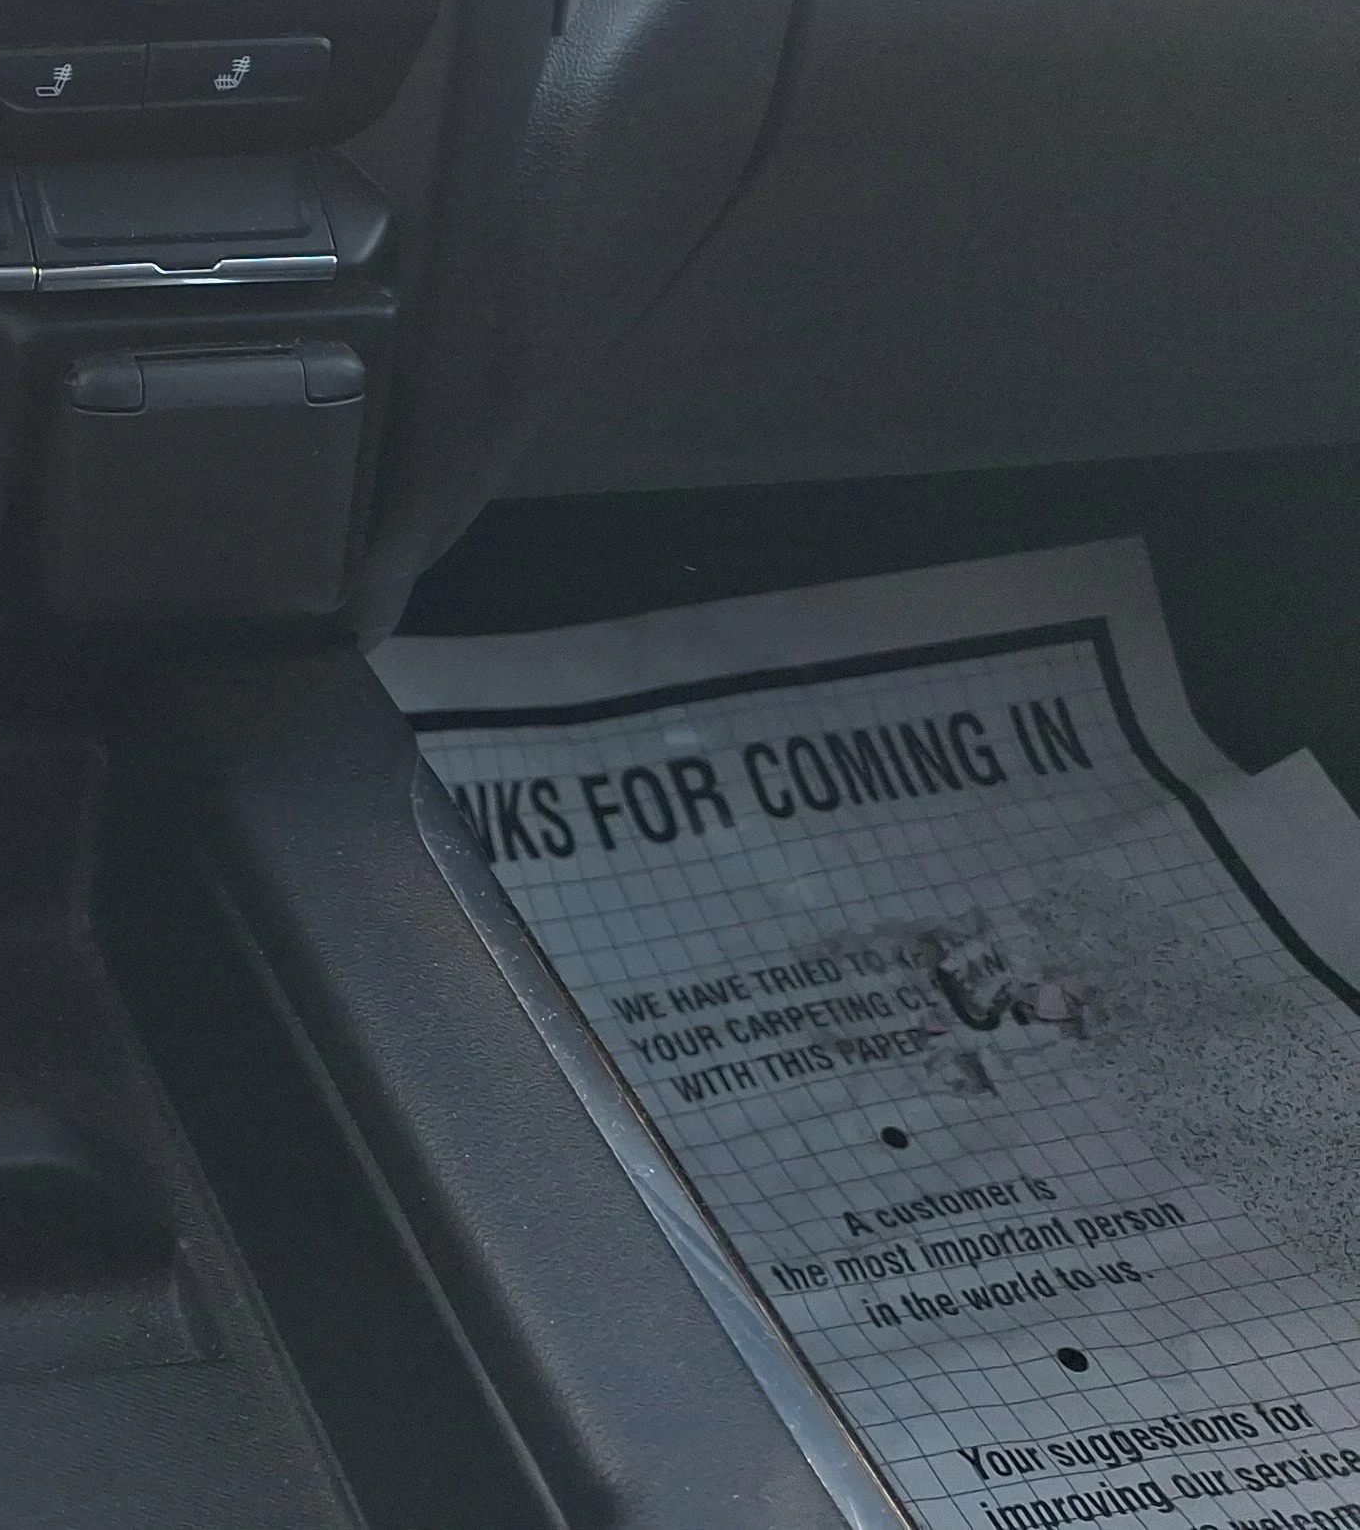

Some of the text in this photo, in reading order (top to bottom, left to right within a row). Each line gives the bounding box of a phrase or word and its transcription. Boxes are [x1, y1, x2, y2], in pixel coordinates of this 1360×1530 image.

[581, 756, 735, 851] FOR
[742, 710, 1009, 819] COMING
[1010, 696, 1093, 776] IN
[613, 992, 668, 1025] WE
[668, 976, 749, 1013] HAVE
[749, 954, 843, 994] TRIED
[631, 1022, 731, 1065] YOUR
[725, 990, 894, 1047] CARPETING
[669, 1065, 759, 1104] WITH
[763, 1041, 835, 1083] THIS
[842, 1174, 1058, 1238] A customer is
[771, 1200, 1188, 1292] the most important person
[865, 1297, 902, 1329] in
[904, 1289, 960, 1319] the
[961, 1267, 1059, 1311] world
[1061, 1265, 1098, 1290] to
[956, 1400, 1315, 1482] Your suggestions for
[980, 1476, 1177, 1530] improving
[1171, 1469, 1234, 1500] our
